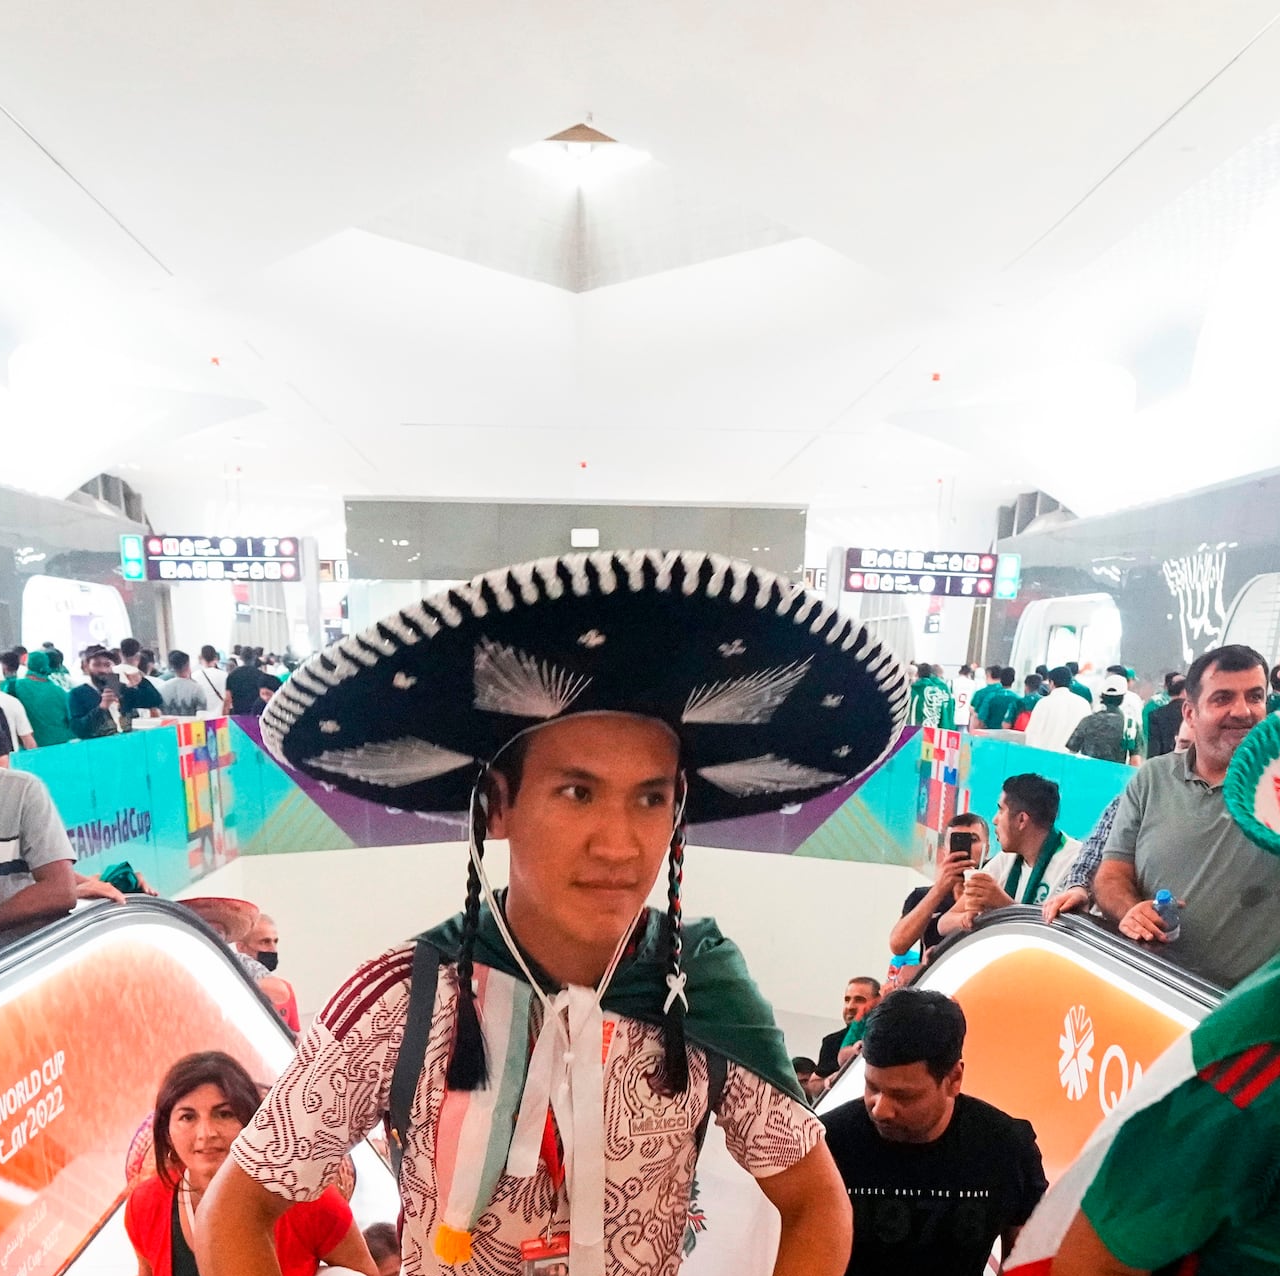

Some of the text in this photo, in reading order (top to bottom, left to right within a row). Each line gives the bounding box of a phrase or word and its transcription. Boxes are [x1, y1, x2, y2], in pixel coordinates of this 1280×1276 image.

[42, 1050, 65, 1085] CUP
[847, 1187, 989, 1198] DIESEL ONLY THE BRAVE
